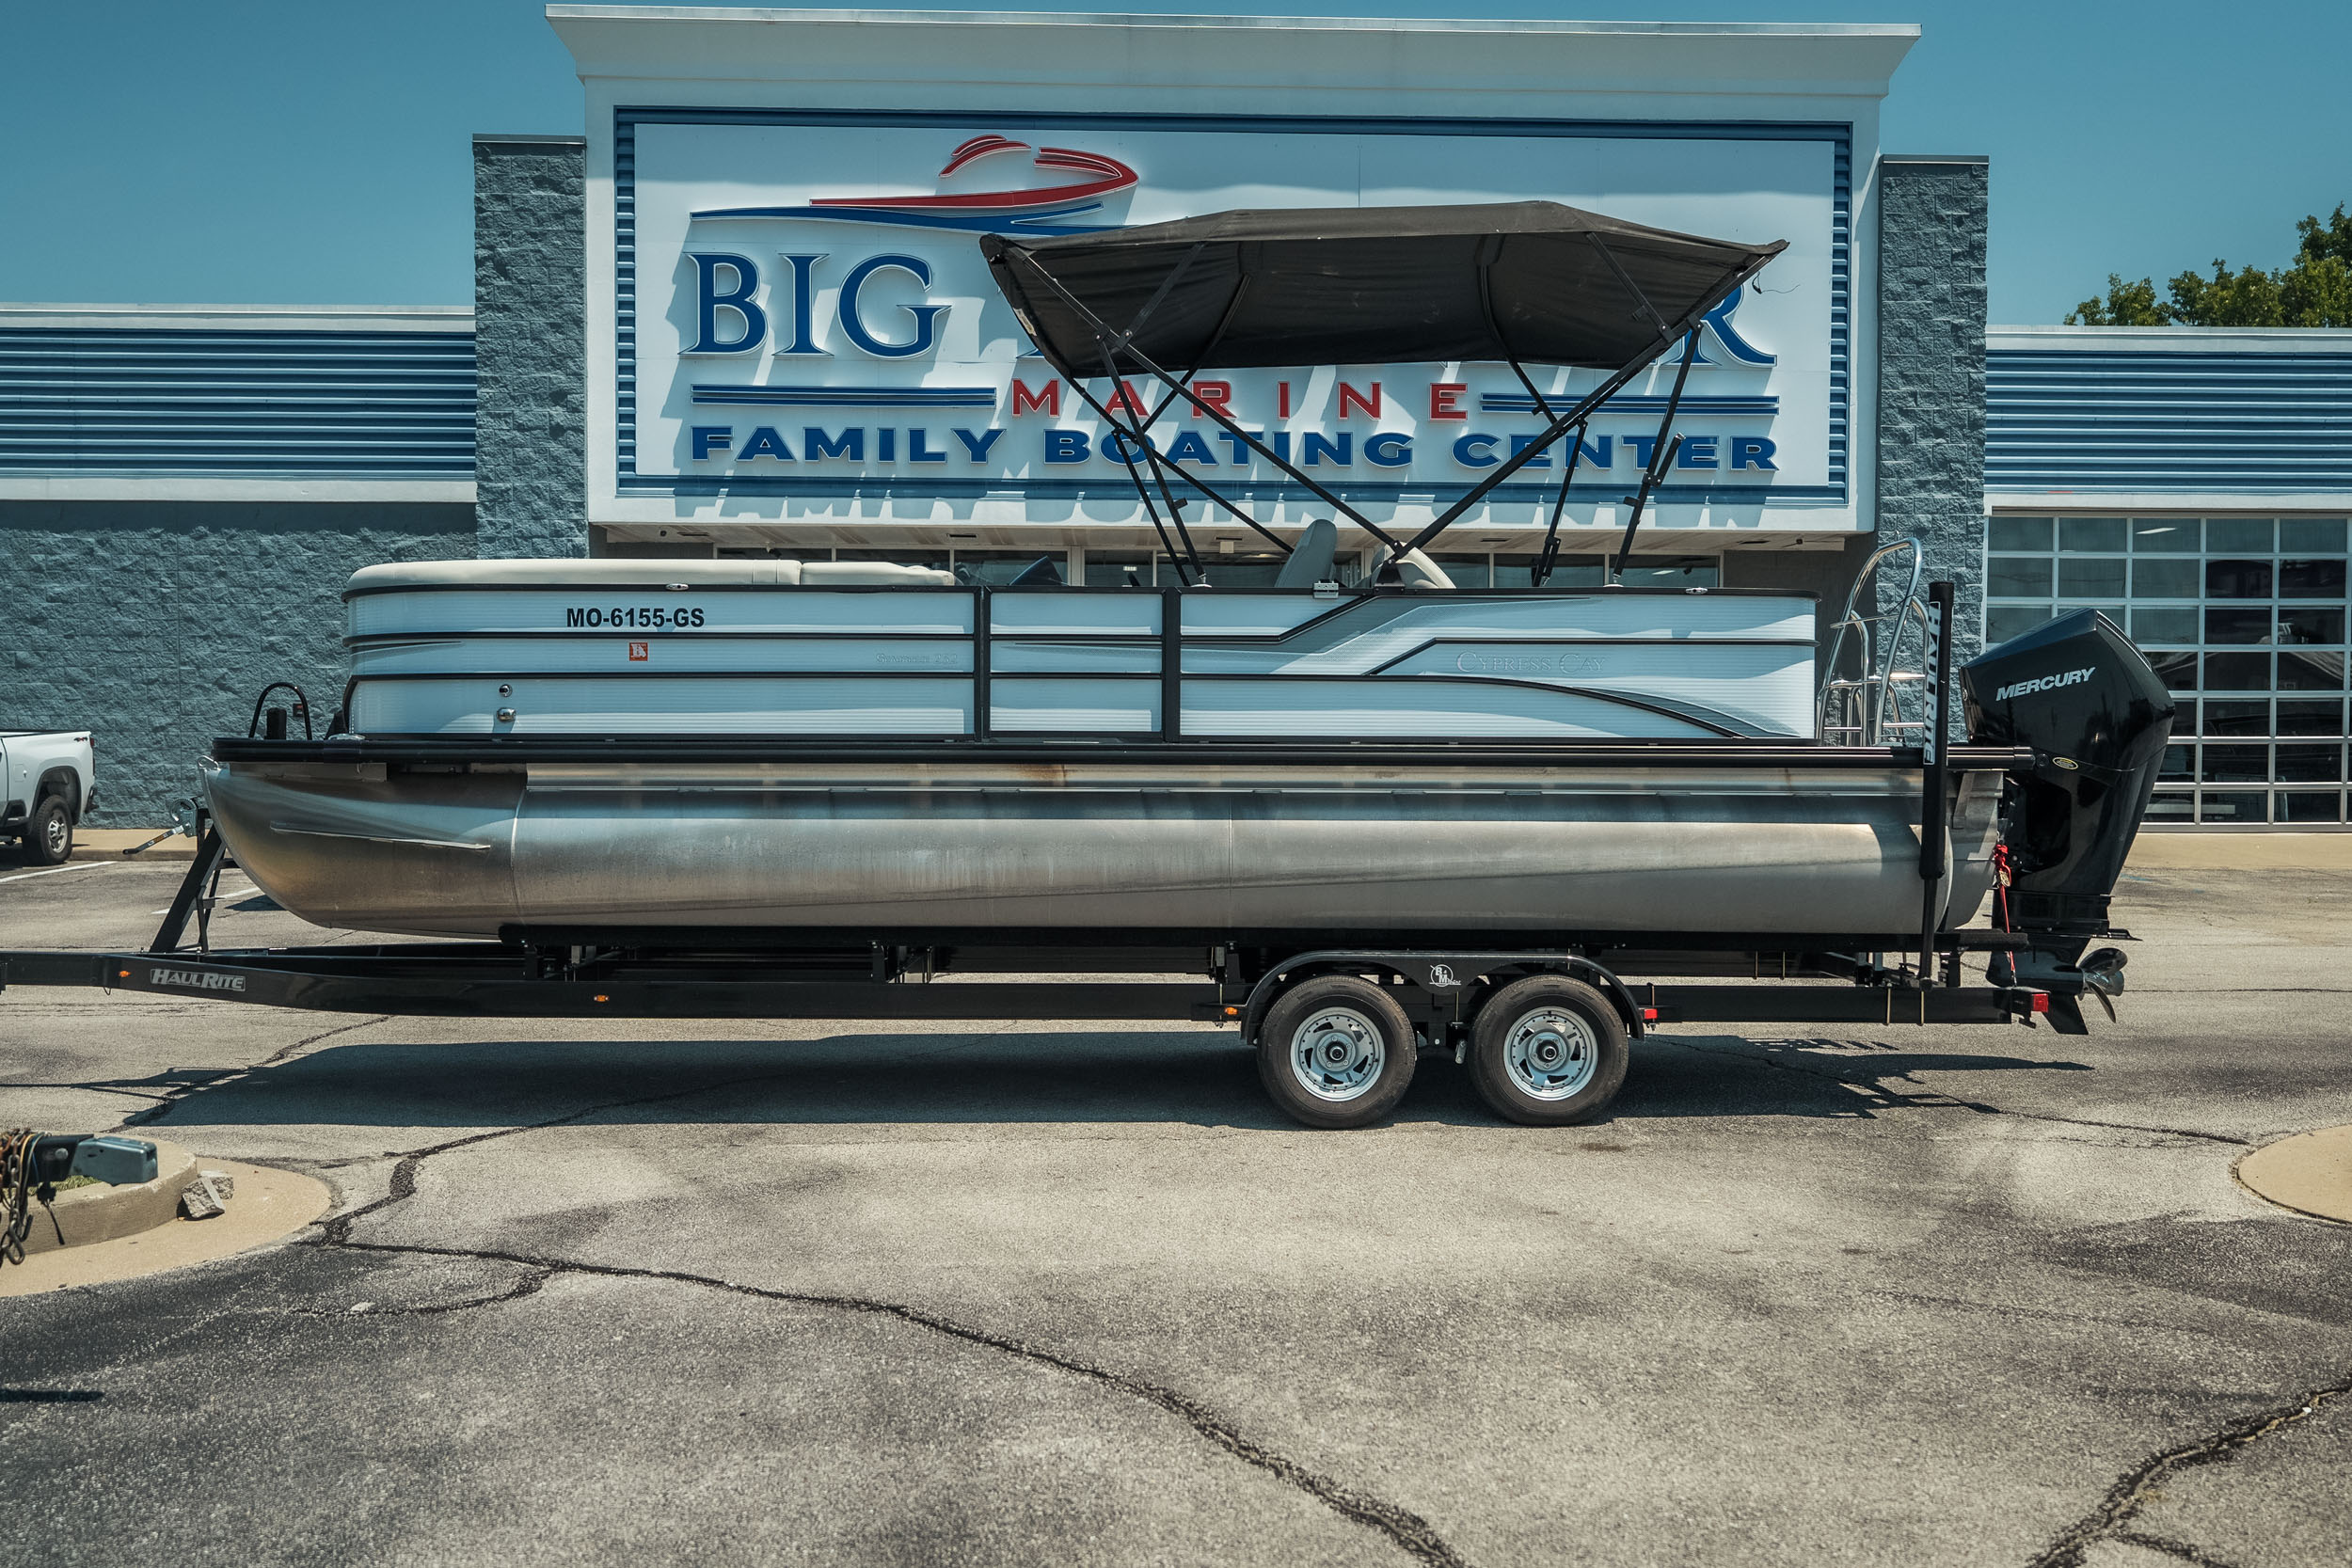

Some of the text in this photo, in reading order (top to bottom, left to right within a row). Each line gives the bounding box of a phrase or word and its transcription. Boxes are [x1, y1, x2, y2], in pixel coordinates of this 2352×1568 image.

[678, 252, 952, 360] BIG
[1011, 378, 1469, 421] MARINE
[691, 425, 1779, 471] FAMILY BOATING CENTER
[566, 608, 705, 627] MO-6155-GS
[1456, 651, 1606, 674] CYPRESS CAY
[1995, 667, 2096, 701] MERCURY
